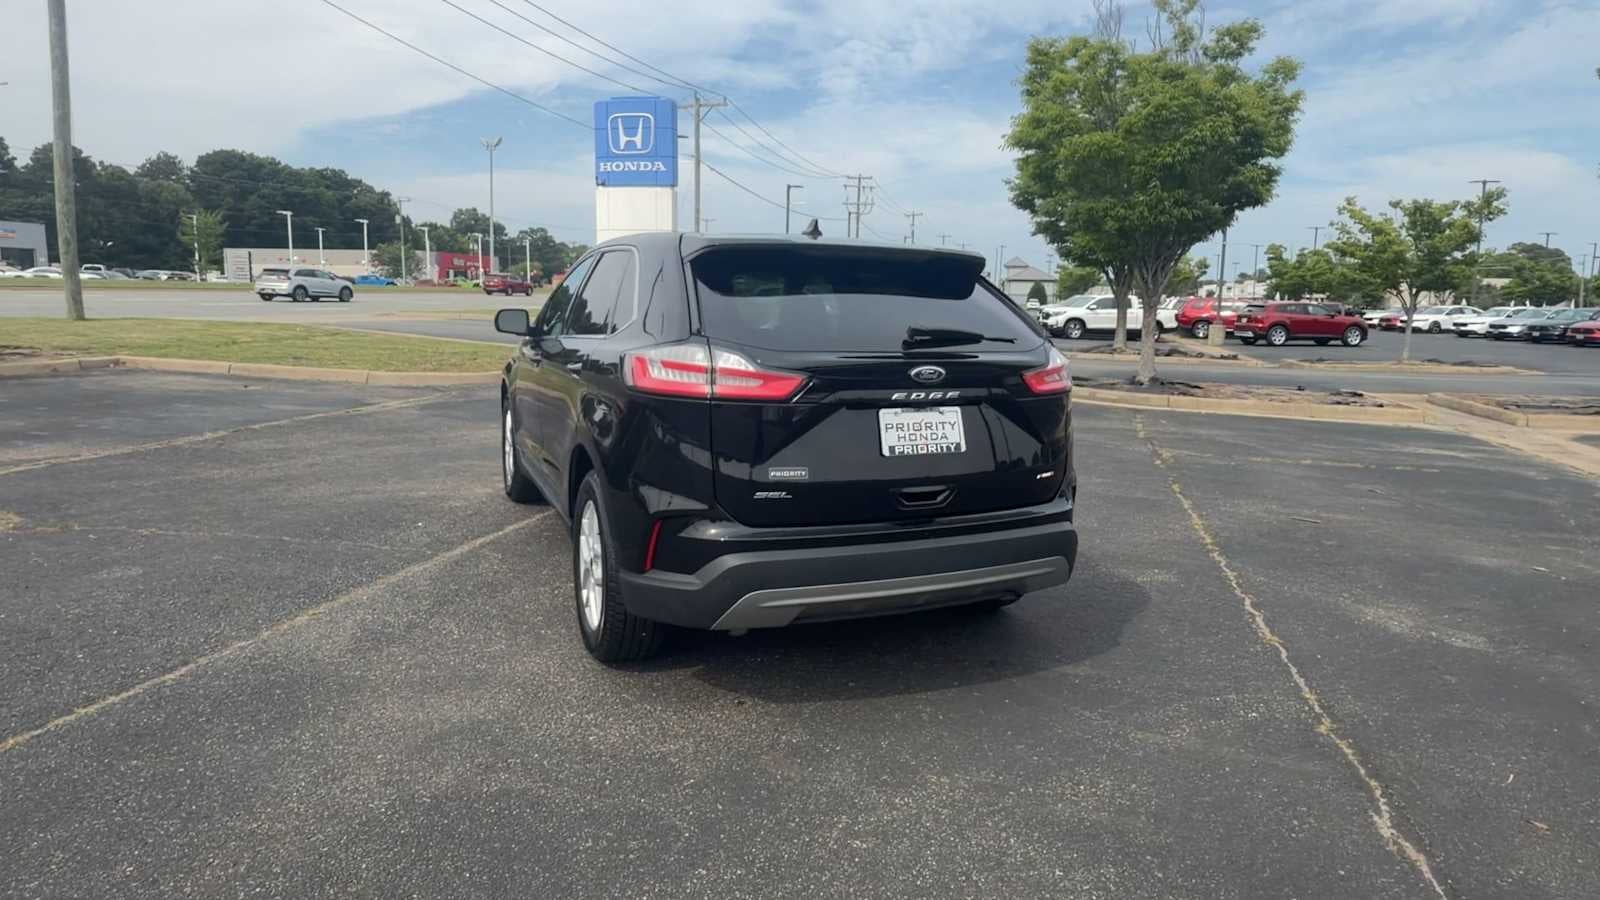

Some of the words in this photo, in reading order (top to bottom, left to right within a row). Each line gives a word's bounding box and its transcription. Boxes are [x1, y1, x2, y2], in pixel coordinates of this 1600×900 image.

[599, 161, 667, 172] HONDA
[891, 391, 961, 400] EDGE
[885, 420, 957, 432] PRIORITY
[897, 432, 949, 442] HONDA
[895, 443, 957, 455] PRIORITY
[753, 491, 792, 499] SEL
